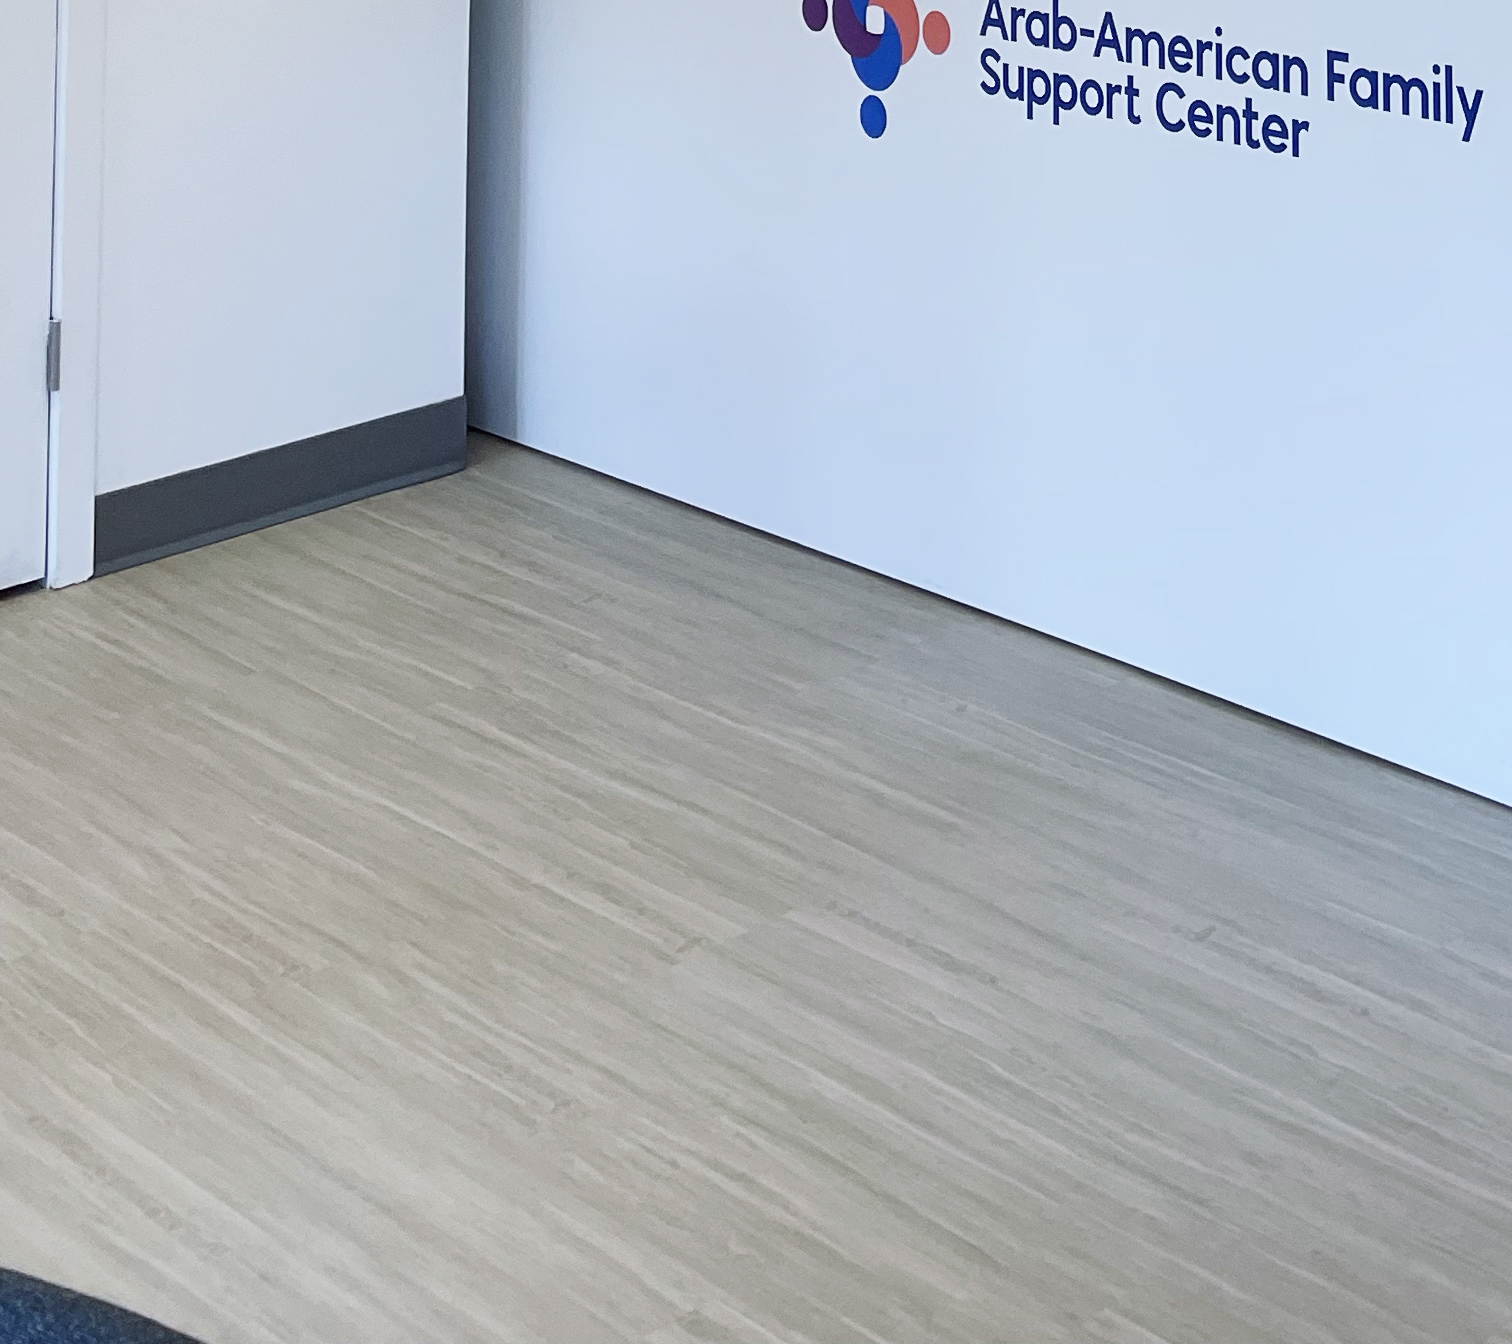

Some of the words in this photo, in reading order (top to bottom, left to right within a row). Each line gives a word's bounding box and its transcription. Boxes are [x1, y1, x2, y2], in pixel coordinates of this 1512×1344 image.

[980, 48, 1142, 125] Support
[1156, 82, 1310, 157] Center
[1327, 50, 1483, 142] Family
